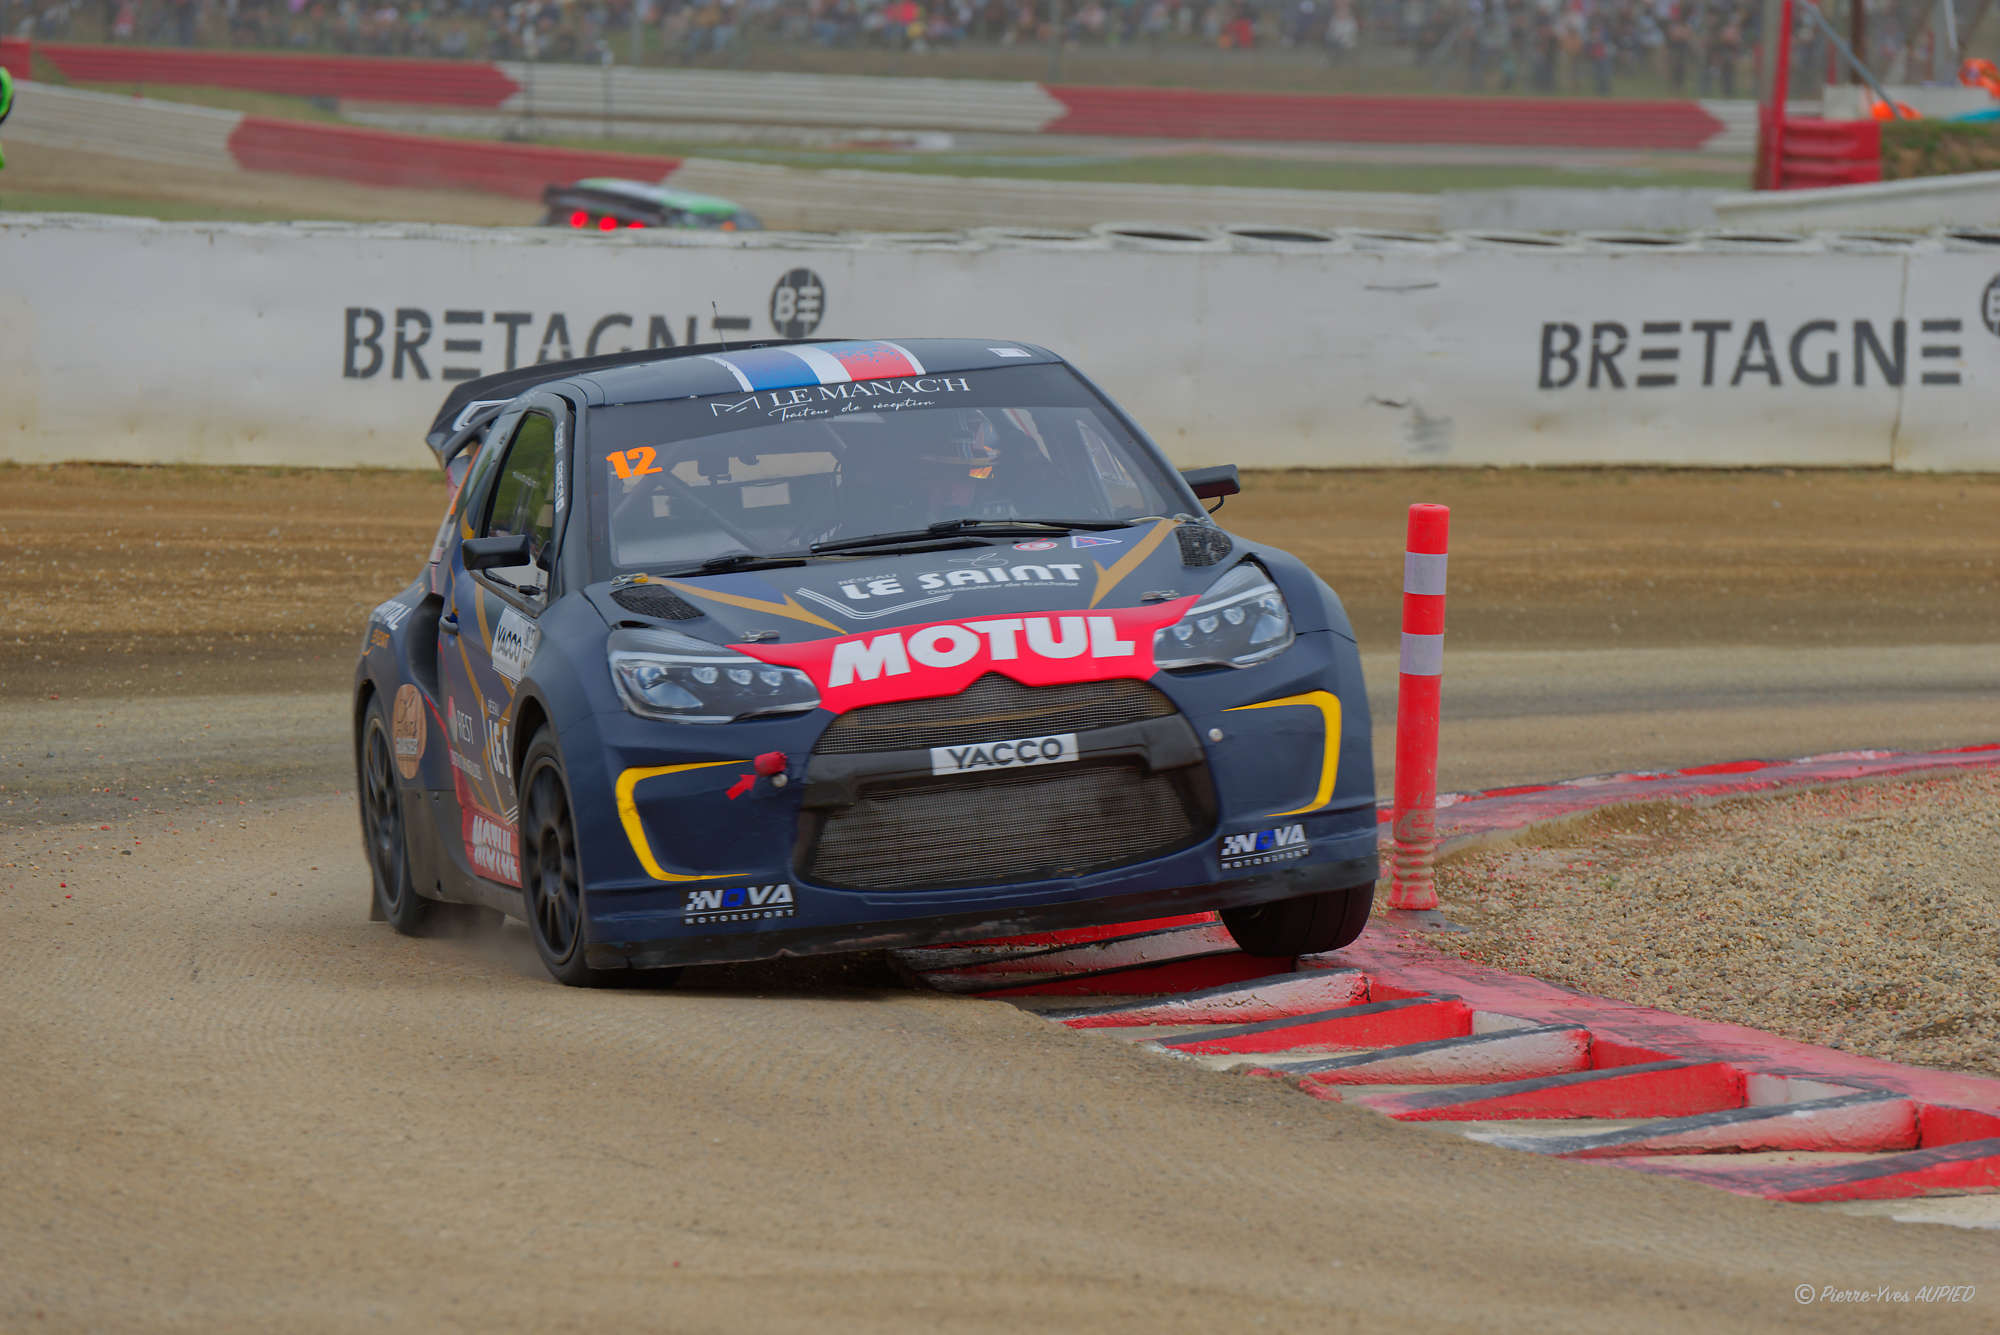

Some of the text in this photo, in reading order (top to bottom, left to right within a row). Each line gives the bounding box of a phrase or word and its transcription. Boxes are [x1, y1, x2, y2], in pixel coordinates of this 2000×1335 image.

[1538, 319, 1963, 390] BRETAGNE
[769, 378, 972, 407] LE MANAC'H
[768, 405, 829, 422] Traiteur
[841, 401, 862, 412] de
[605, 446, 664, 480] 12
[840, 563, 1083, 600] LE SAINT
[828, 616, 1136, 688] MOTUL
[947, 737, 1063, 770] YACCO
[1231, 824, 1308, 854] NOVA
[695, 884, 793, 910] NOVA
[684, 909, 794, 924] MOTORSPORT
